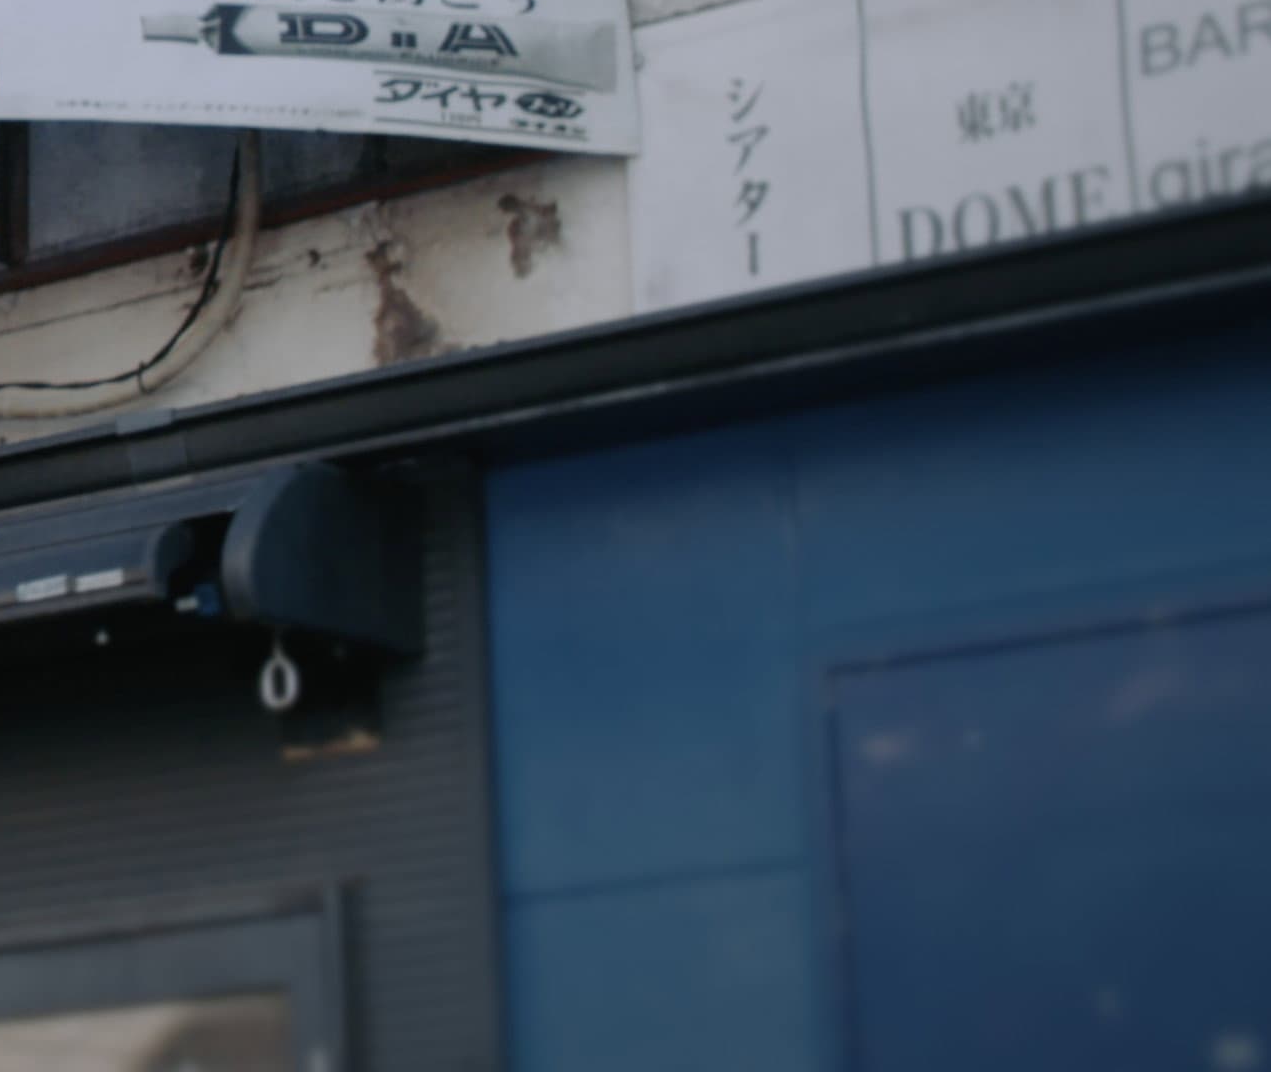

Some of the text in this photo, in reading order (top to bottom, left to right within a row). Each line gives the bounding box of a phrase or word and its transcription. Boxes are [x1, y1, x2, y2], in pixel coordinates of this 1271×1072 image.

[373, 78, 506, 113] ダイヤ
[956, 81, 1039, 144] 東京
[726, 77, 770, 276] シアター
